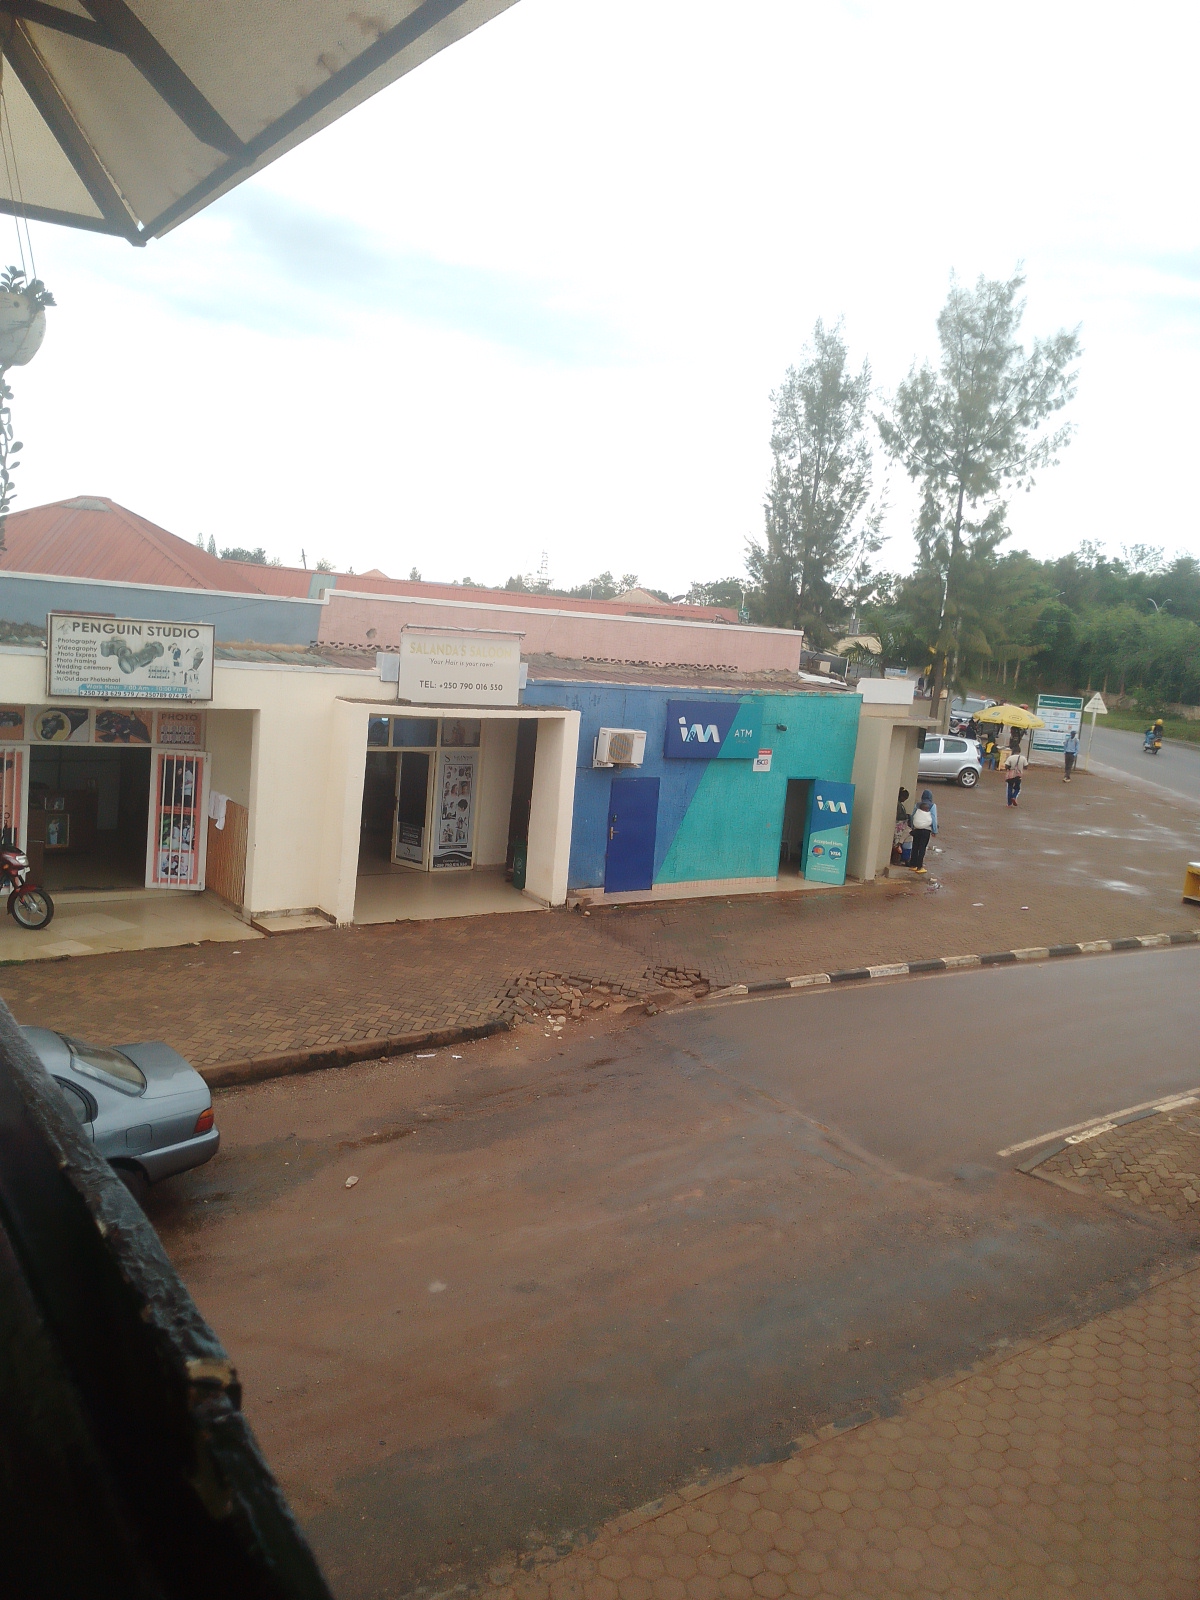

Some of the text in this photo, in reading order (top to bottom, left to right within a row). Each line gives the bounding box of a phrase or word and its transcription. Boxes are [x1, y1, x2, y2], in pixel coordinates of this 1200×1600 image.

[72, 621, 200, 639] PENGUIN STUDIO
[410, 642, 512, 658] SALANDA'S SALOON
[419, 680, 437, 689] TEL:
[439, 682, 458, 690] +250
[460, 682, 474, 690] 790
[475, 683, 488, 691] 016
[734, 729, 753, 738] ATM
